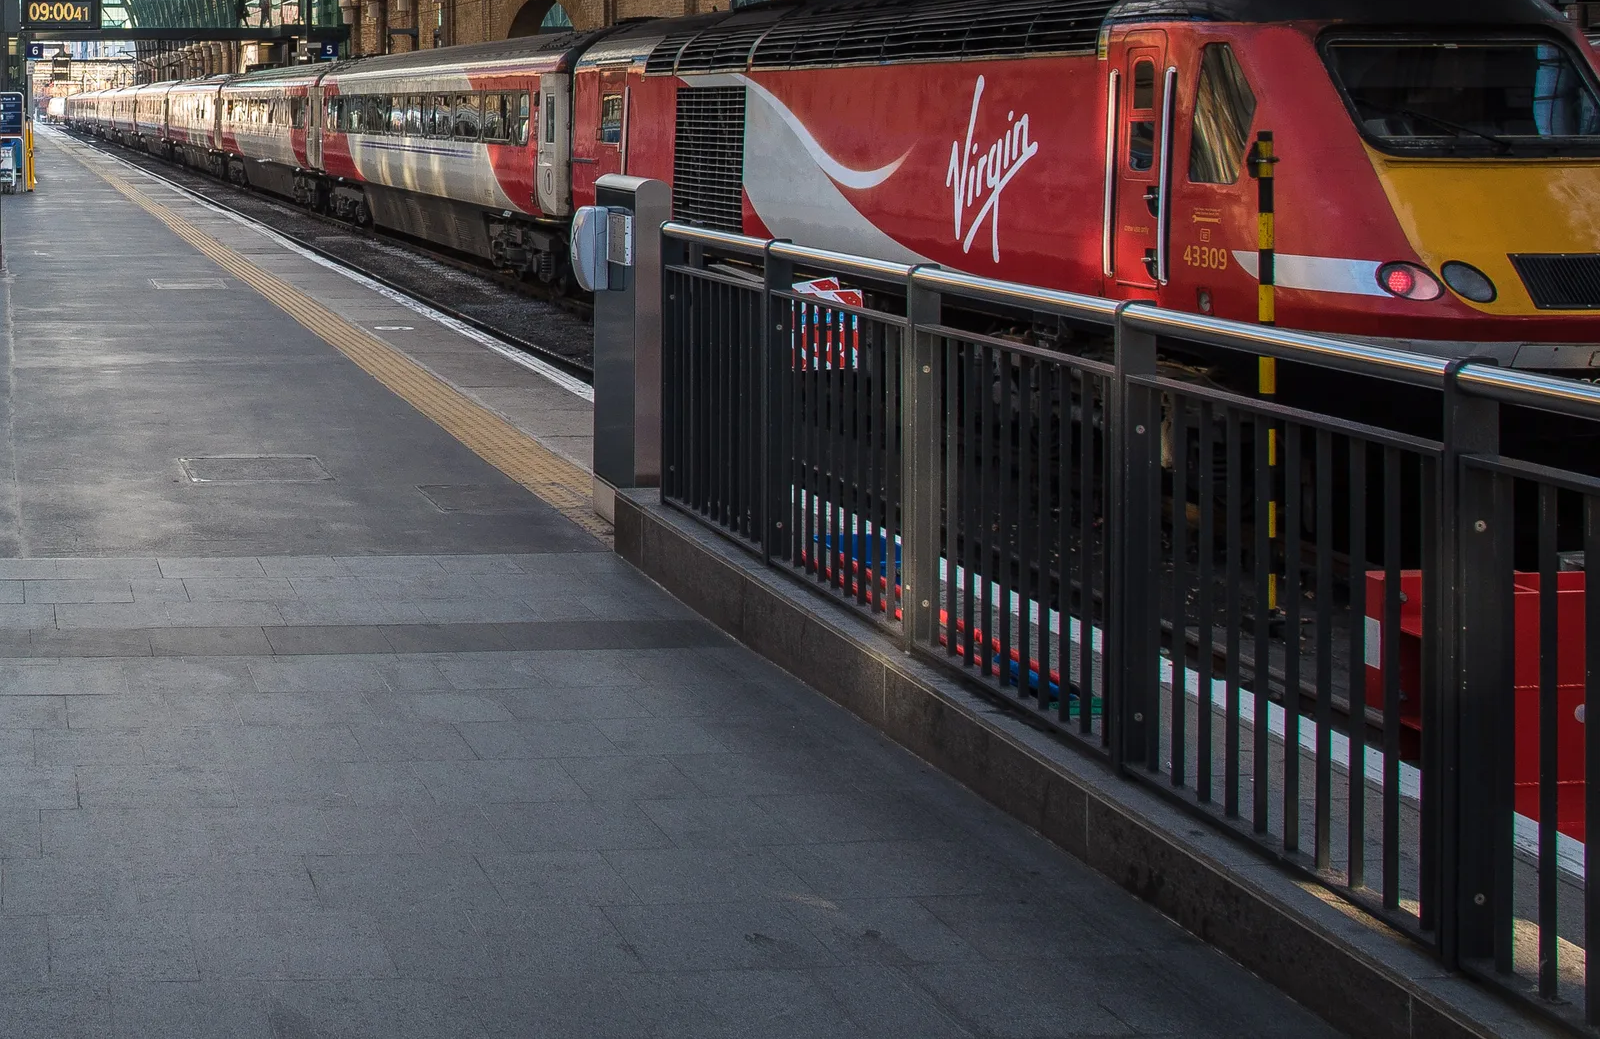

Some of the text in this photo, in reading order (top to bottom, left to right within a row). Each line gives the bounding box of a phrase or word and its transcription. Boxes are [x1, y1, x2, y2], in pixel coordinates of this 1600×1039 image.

[31, 46, 39, 56] 6
[326, 45, 333, 54] 5
[946, 74, 1038, 263] Virgin
[1183, 244, 1228, 270] 43309
